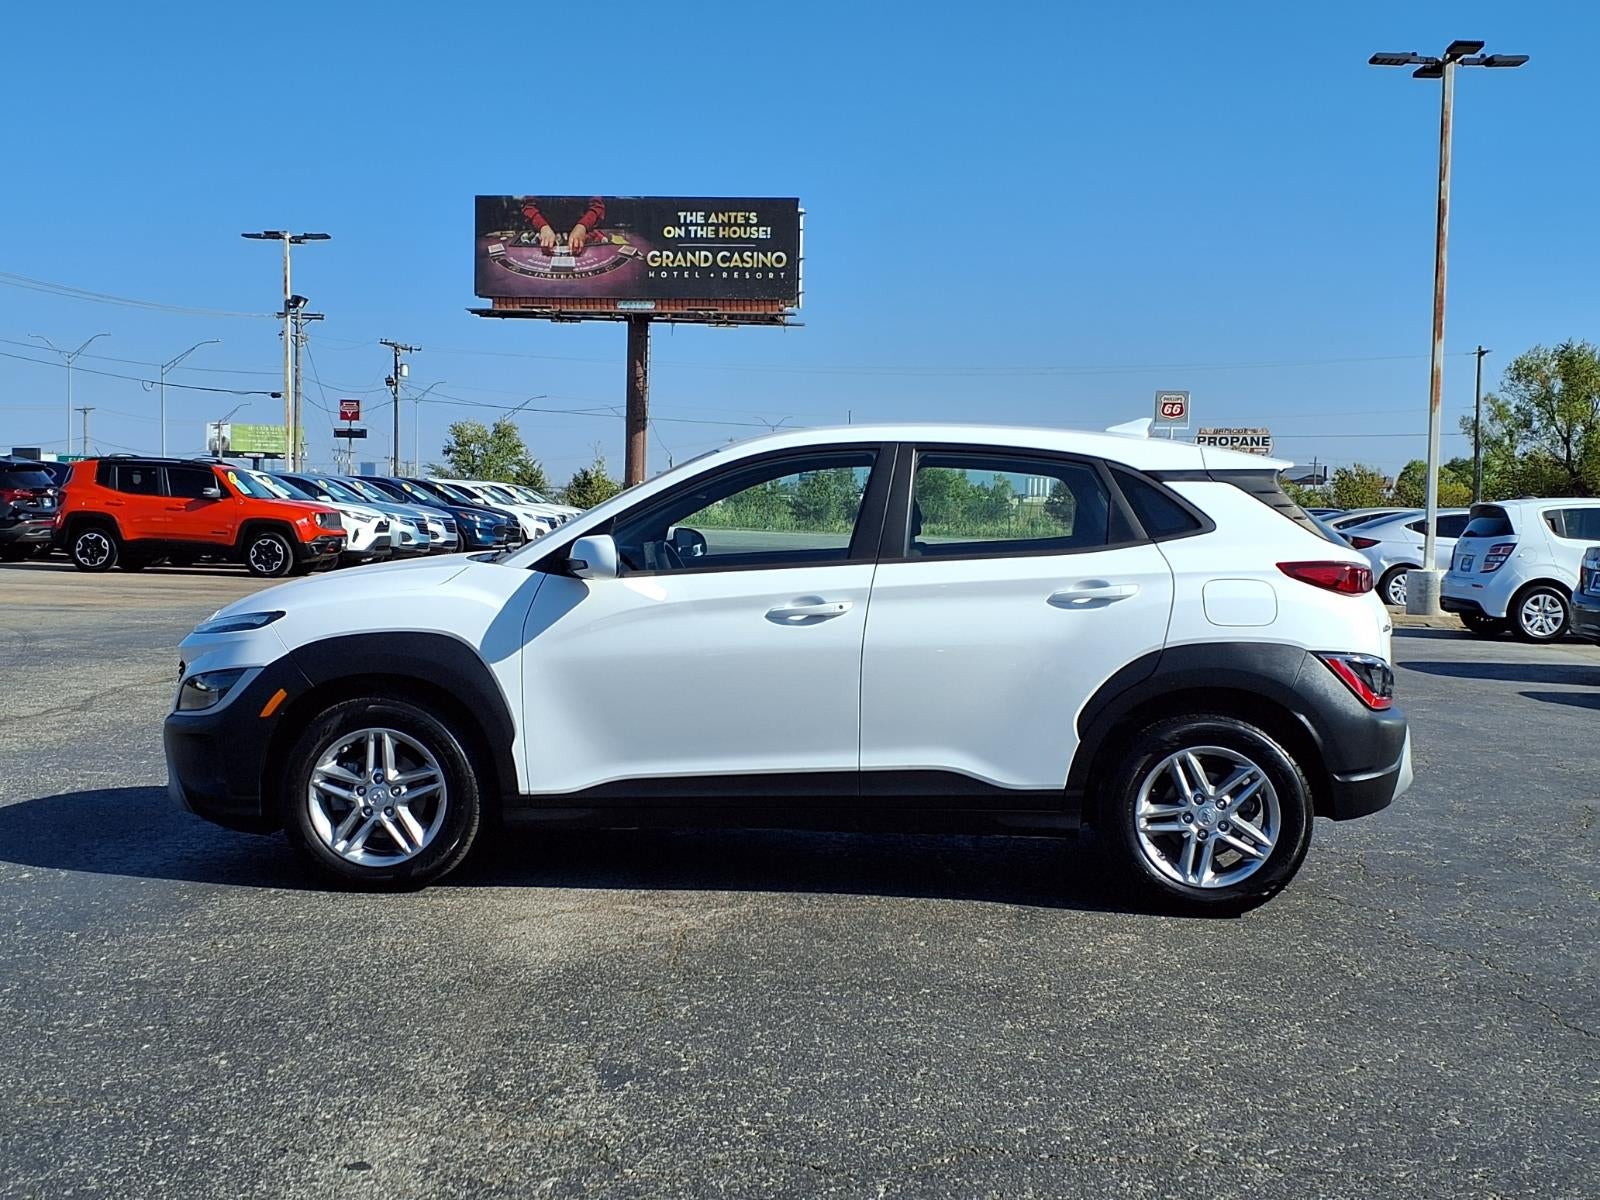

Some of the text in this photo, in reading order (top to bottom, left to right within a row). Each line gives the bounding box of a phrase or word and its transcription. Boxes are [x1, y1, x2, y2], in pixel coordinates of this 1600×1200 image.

[678, 212, 758, 224] THE ANTE'S
[663, 226, 772, 239] ON THE HOUSE!
[646, 251, 788, 268] GRAND CASINO
[1163, 403, 1182, 415] 66
[1197, 436, 1271, 447] PROPANE
